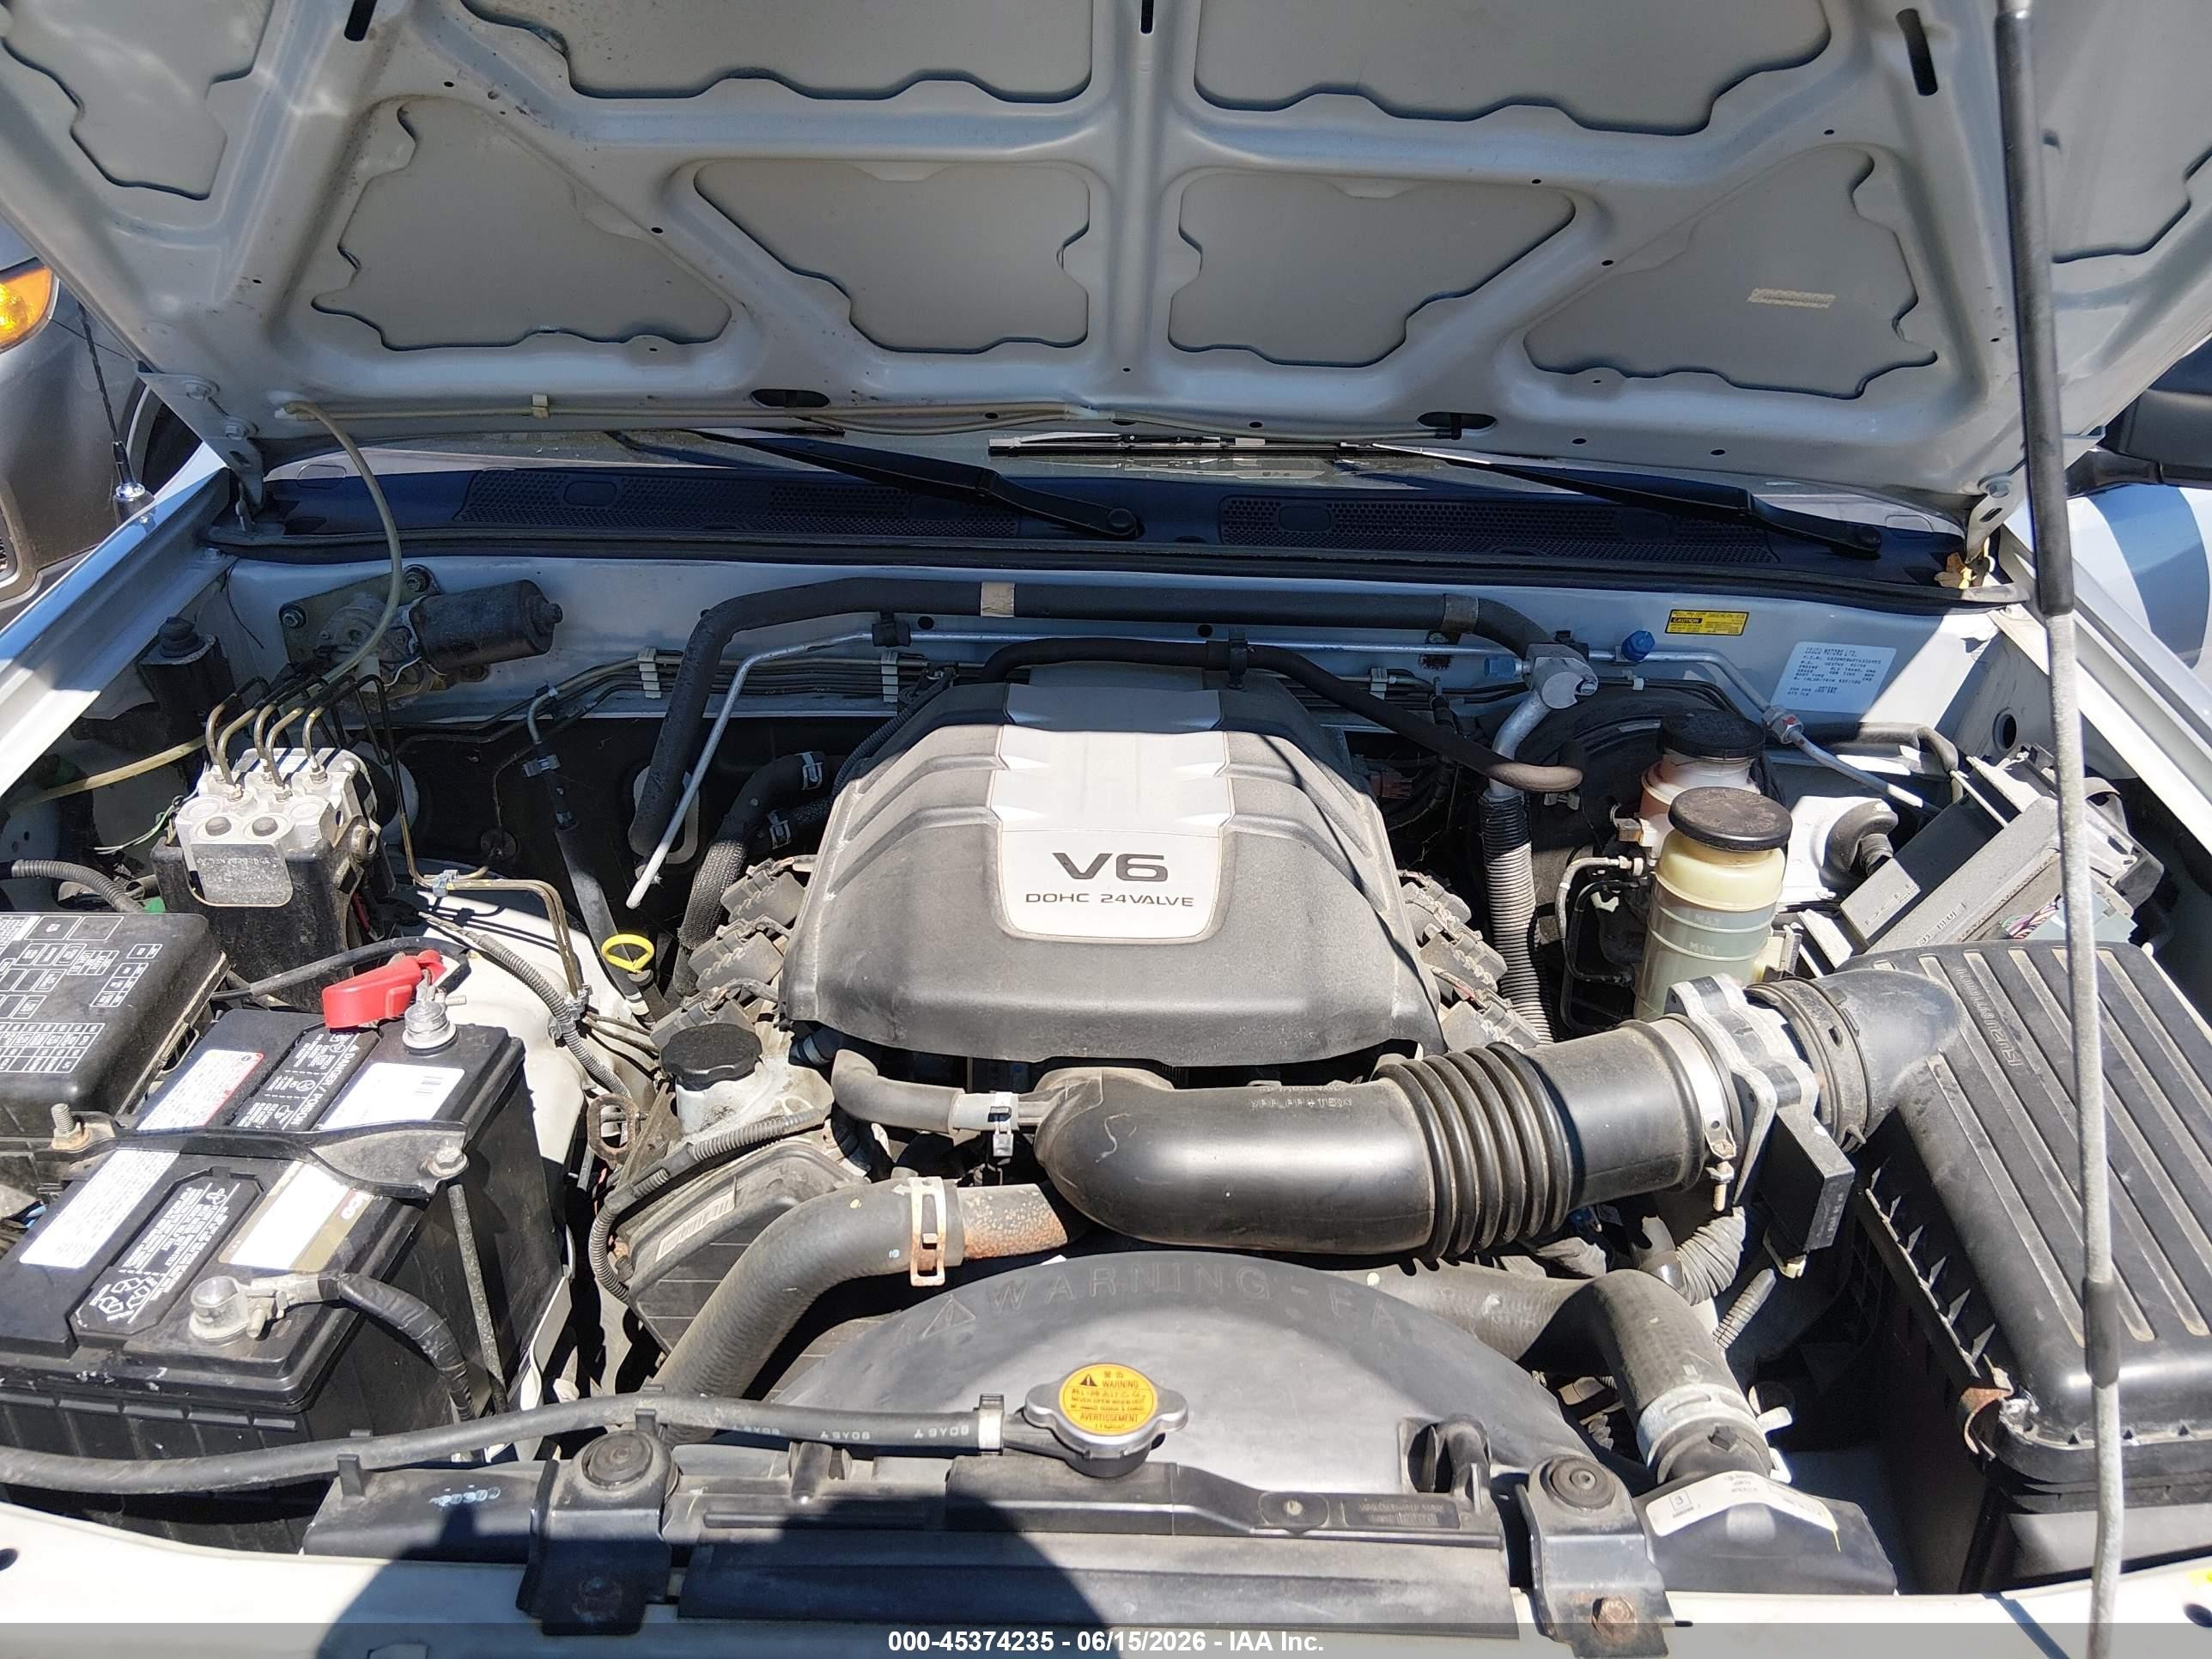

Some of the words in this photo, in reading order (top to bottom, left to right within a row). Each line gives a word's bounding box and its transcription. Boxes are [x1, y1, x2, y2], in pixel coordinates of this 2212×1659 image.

[1052, 853, 1168, 882] V6
[1025, 893, 1090, 903] DOHC
[1100, 894, 1194, 907] 24VALVE
[1695, 913, 1722, 927] MAX
[1689, 942, 1716, 955] MIN
[323, 1053, 356, 1085] DANGER
[291, 1093, 324, 1126] POISON
[994, 1263, 1271, 1316] WARNING
[1102, 1380, 1139, 1389] WARNING
[1079, 1413, 1139, 1423] AVERTISSEMENT
